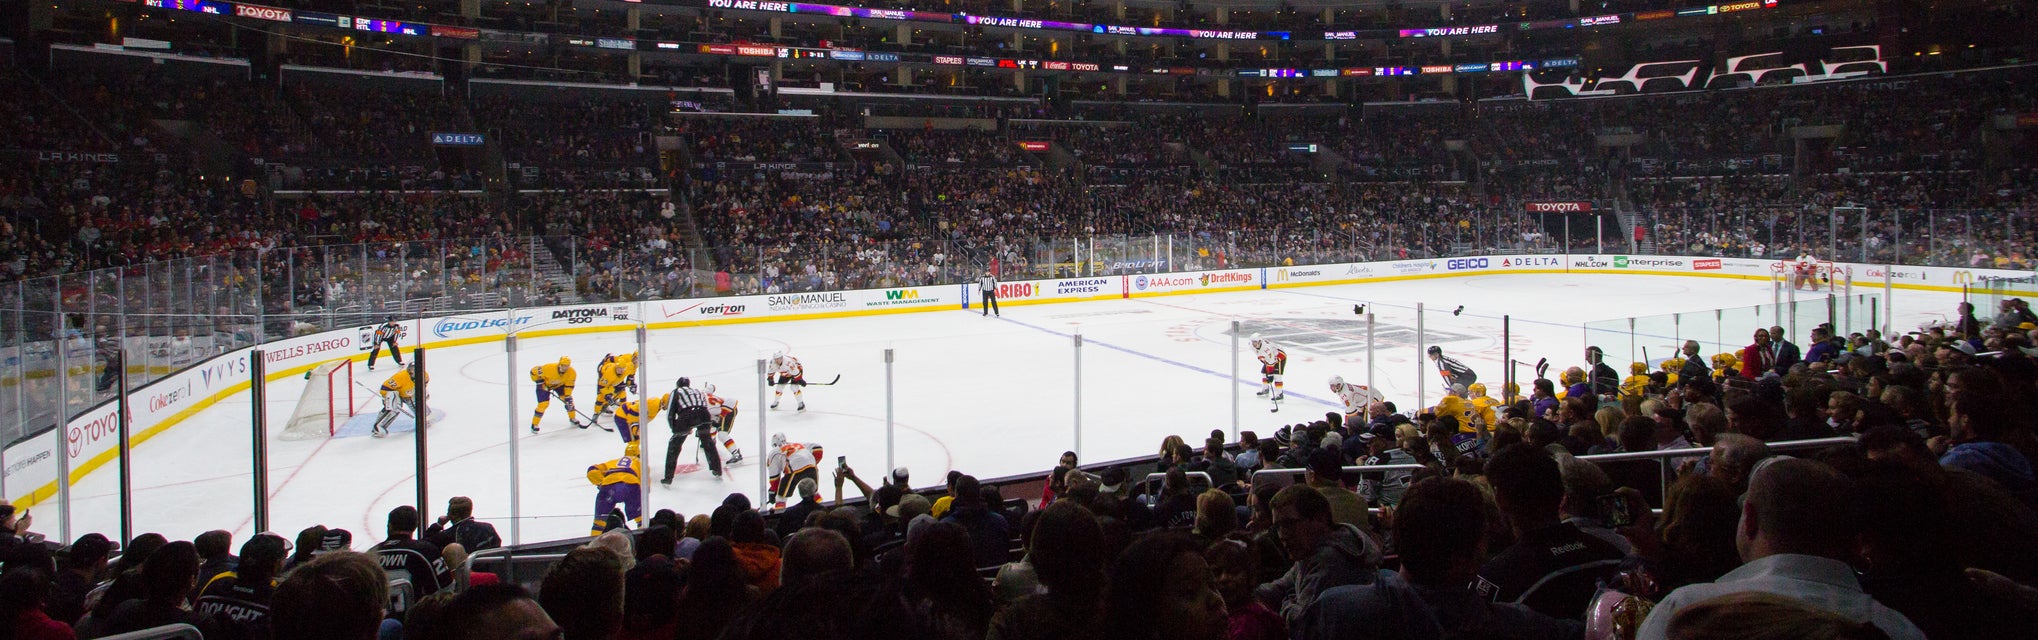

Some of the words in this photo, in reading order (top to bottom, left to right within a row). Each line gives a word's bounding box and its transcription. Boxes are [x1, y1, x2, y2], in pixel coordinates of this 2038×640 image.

[709, 0, 732, 8] YOU
[734, 0, 757, 10] ARE
[759, 2, 788, 12] HERE
[1730, 2, 1760, 10] TOYOTA
[237, 5, 292, 22] TOYOTA
[979, 17, 998, 25] YOU
[999, 18, 1017, 27] ARE
[1019, 19, 1043, 28] HERE
[1199, 30, 1215, 38] YOU
[1217, 31, 1233, 39] ARE
[1234, 32, 1258, 40] HERE
[1427, 28, 1448, 36] YOU
[1450, 27, 1469, 35] ARE
[1471, 25, 1498, 34] HERE
[738, 46, 775, 56] TOSHIBA
[935, 56, 962, 65] STAPLES
[1072, 63, 1099, 71] TOYOTA
[1421, 66, 1452, 74] TOSHIBA
[446, 135, 483, 143] DELTA
[39, 152, 63, 161] LA
[68, 152, 119, 163] KINGS
[1535, 203, 1581, 211] TOYOTA
[1447, 258, 1489, 270] GEICO
[1515, 257, 1559, 266] DELTA
[1574, 260, 1608, 268] NHL.COM
[1616, 258, 1683, 267] enterprise
[1693, 260, 1721, 269] STAPLES
[1211, 272, 1252, 284] DraftKings
[1891, 271, 1917, 279] zero
[1058, 279, 1107, 288] AMERICAN
[1149, 276, 1194, 288] AAA.com
[886, 289, 918, 300] WM
[993, 282, 1032, 299] ARIBO
[1057, 286, 1099, 295] EXPRESS
[768, 295, 791, 307] SAN
[800, 292, 847, 304] MANUEL
[891, 297, 940, 305] MANAGEMENT
[552, 307, 607, 319] DAYTONA
[700, 303, 745, 315] verizon
[568, 316, 593, 324] 500
[613, 313, 629, 321] FOX
[440, 321, 480, 334] BUD
[266, 345, 304, 363] WELLS
[306, 337, 350, 355] FARGO
[149, 393, 169, 413] Coke
[168, 386, 186, 405] zero
[617, 456, 632, 467] 8
[1550, 541, 1587, 556] Reebok
